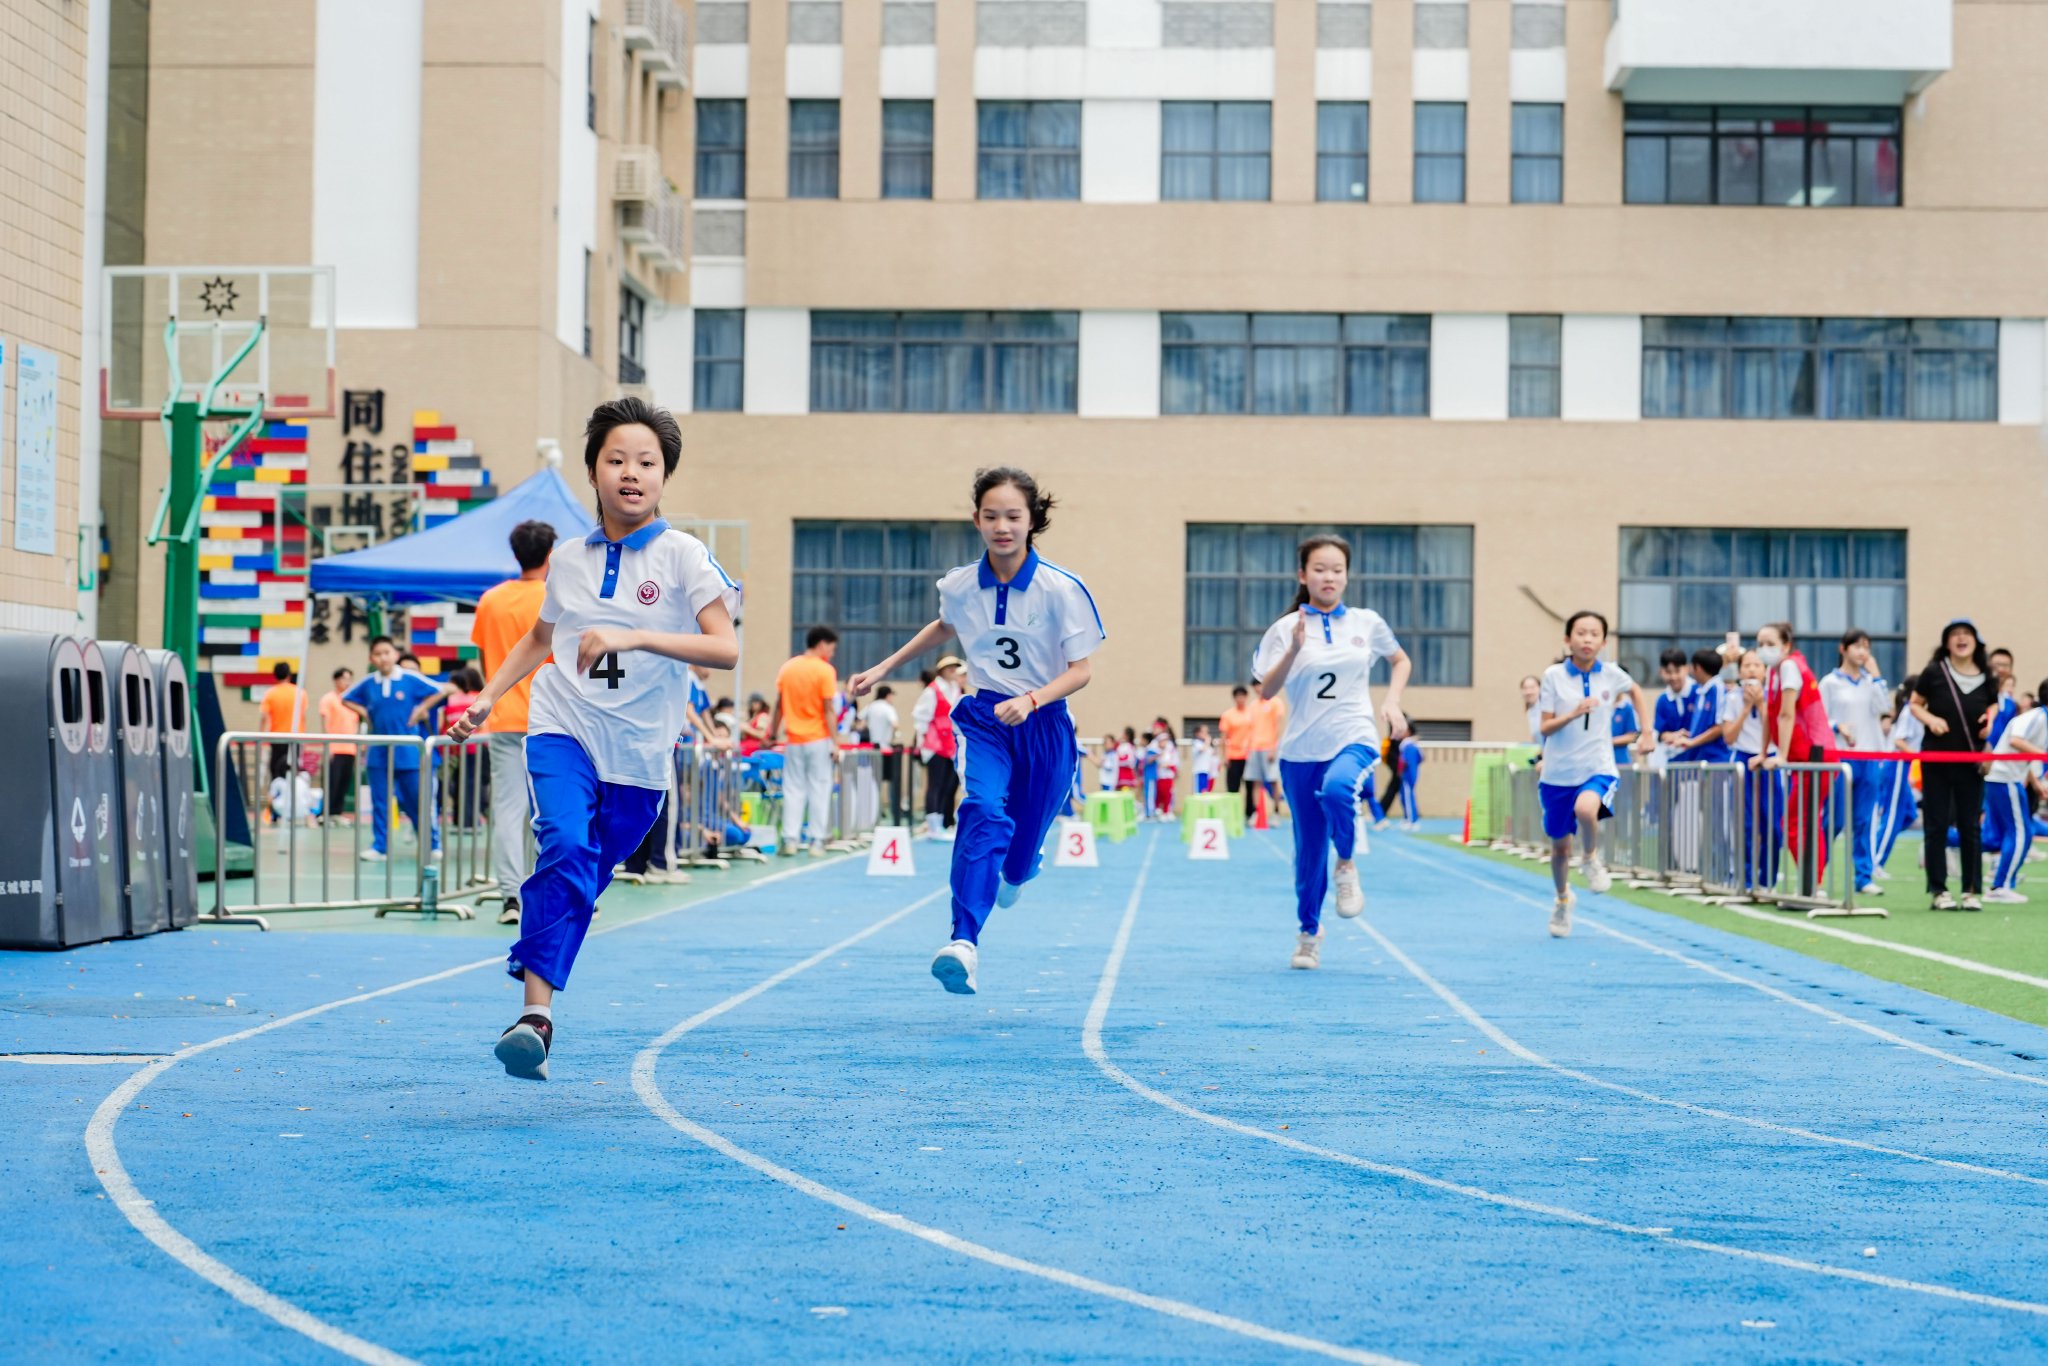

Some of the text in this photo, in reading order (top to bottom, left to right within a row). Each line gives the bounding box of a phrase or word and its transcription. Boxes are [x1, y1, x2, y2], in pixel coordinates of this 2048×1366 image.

[995, 637, 1022, 670] 3
[589, 650, 626, 689] 4
[1317, 672, 1337, 699] 2
[881, 838, 900, 865] 4
[1069, 833, 1085, 857] 3
[1203, 828, 1217, 850] 2
